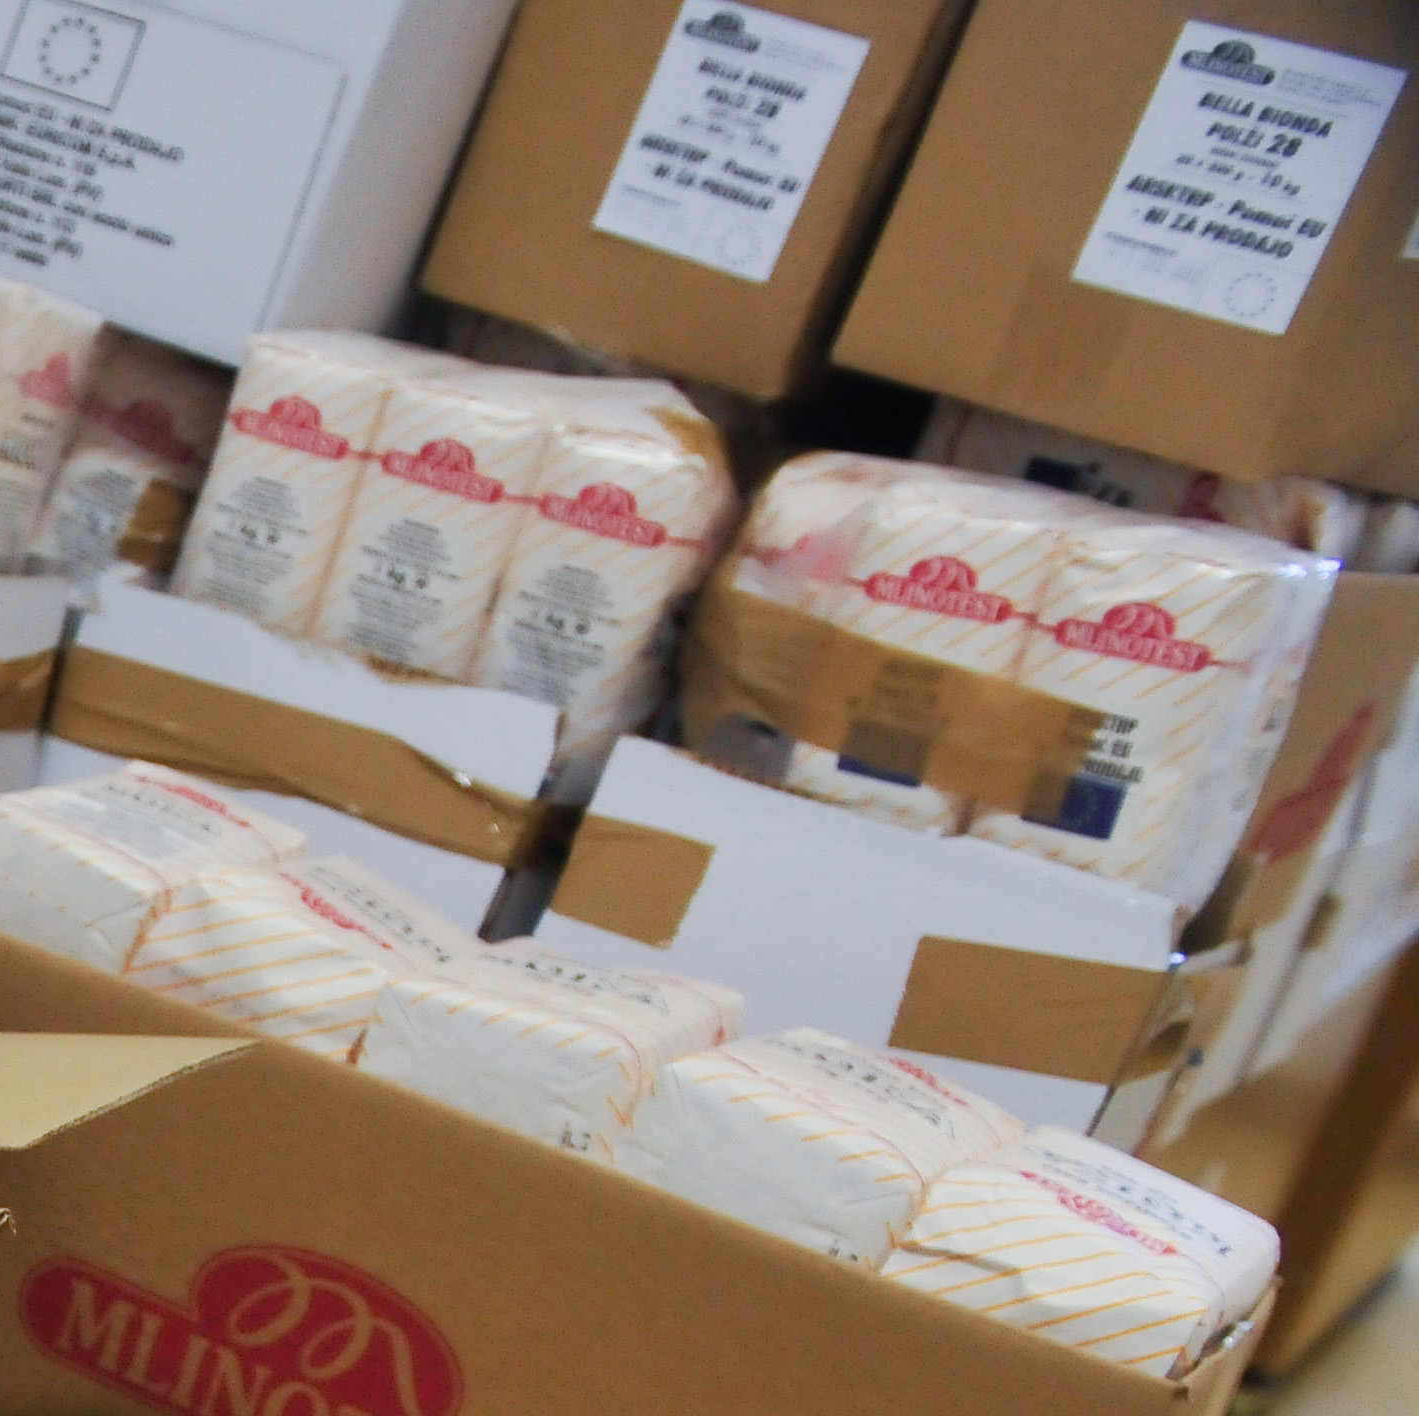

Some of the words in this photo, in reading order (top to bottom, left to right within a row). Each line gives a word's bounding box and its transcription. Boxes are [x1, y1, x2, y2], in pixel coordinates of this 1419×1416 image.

[1197, 91, 1255, 118] BELLA
[1256, 104, 1333, 138] BIONDA
[1199, 220, 1294, 259] PRODAJO
[1062, 619, 1198, 672] MLINOTEST
